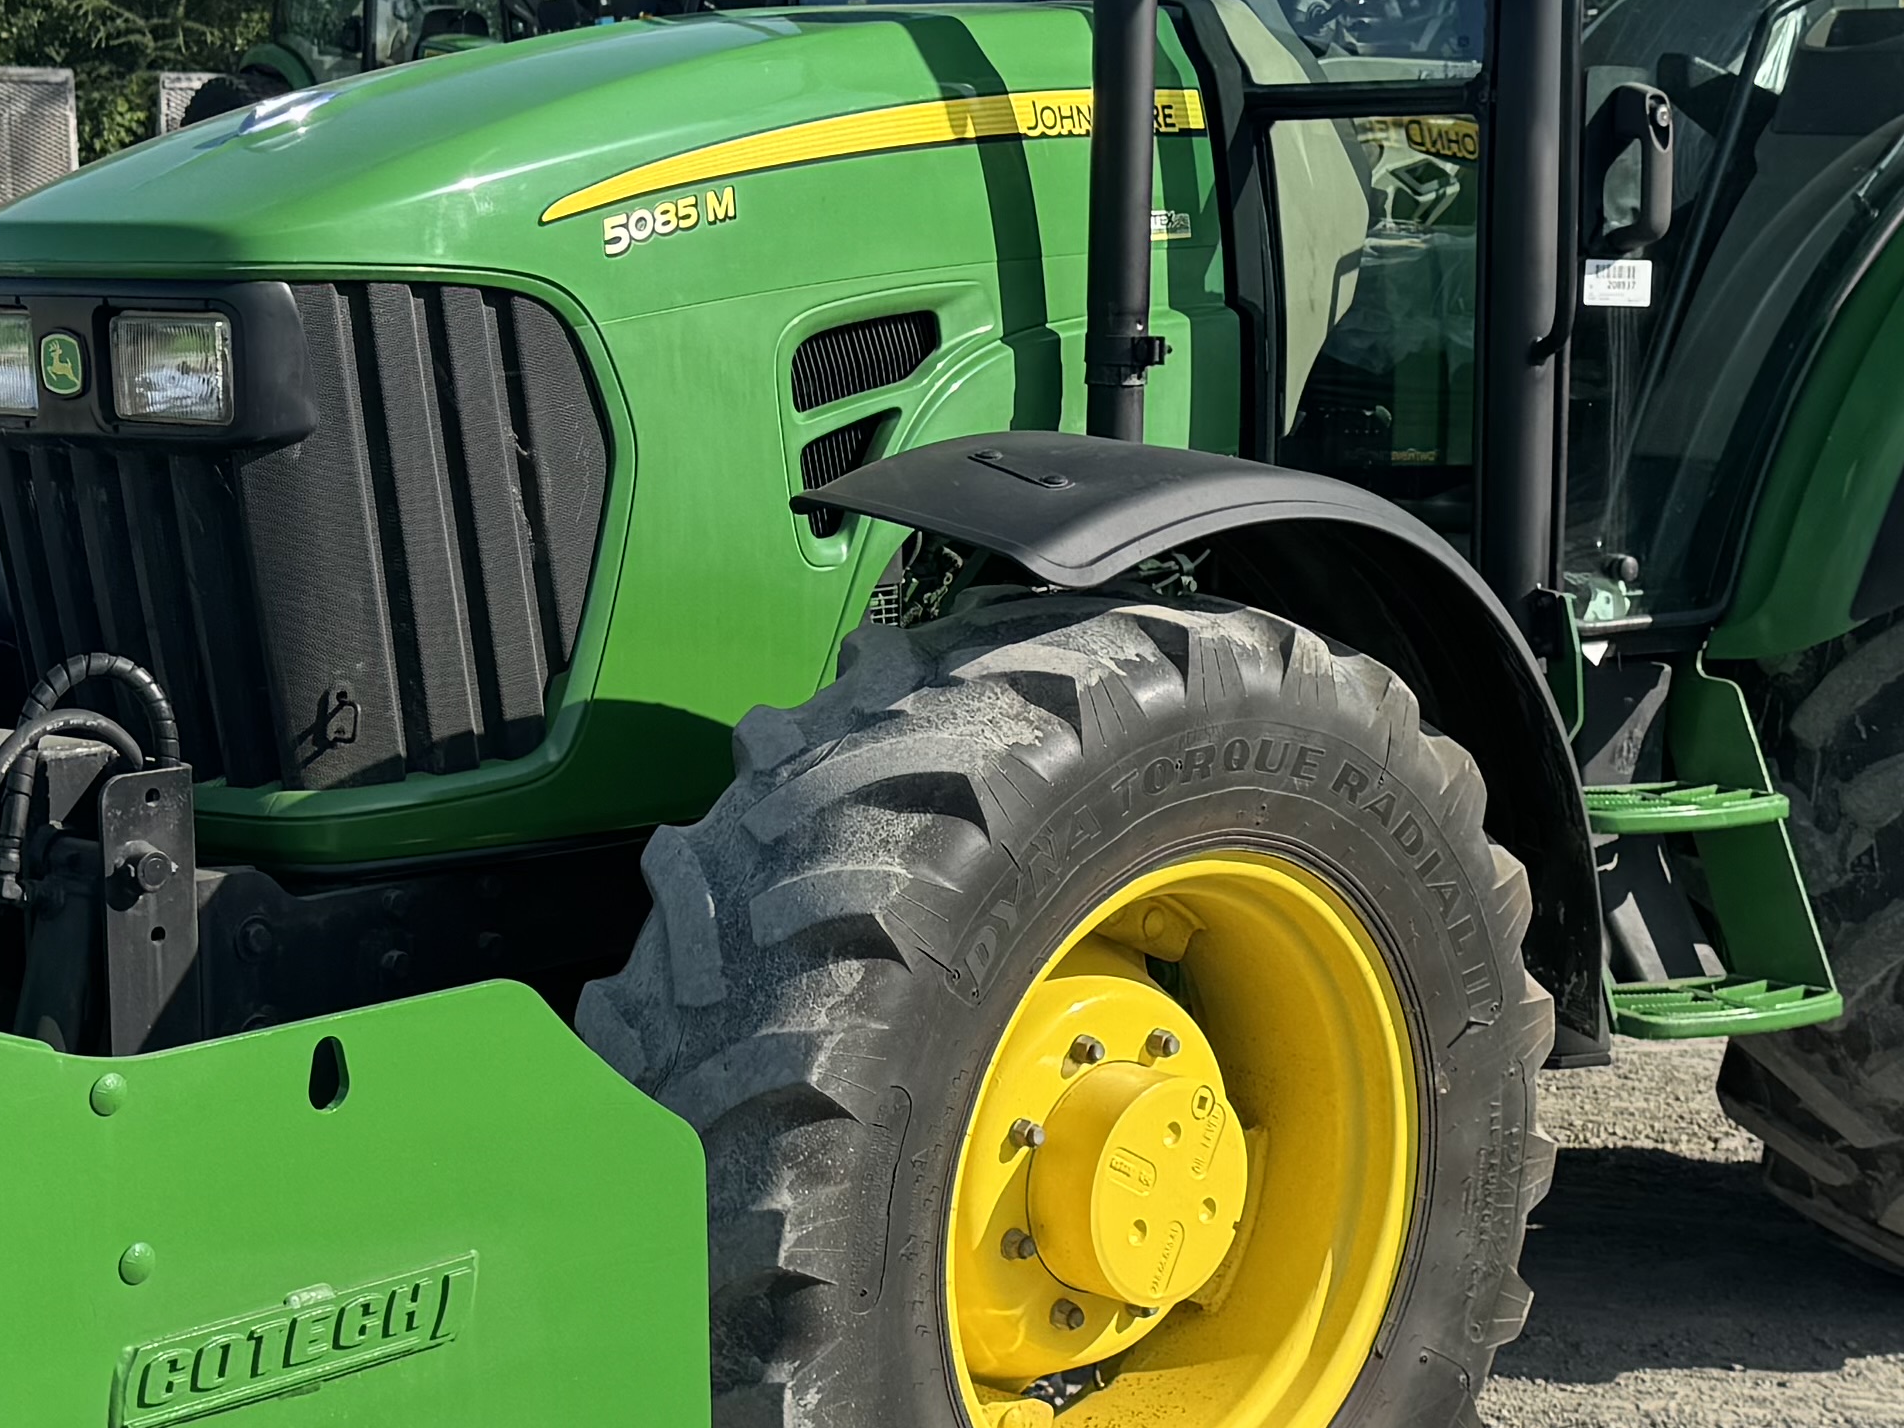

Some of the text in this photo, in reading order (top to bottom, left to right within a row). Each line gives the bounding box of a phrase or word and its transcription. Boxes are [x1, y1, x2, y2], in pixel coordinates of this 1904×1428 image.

[1027, 100, 1092, 130] JOHN
[603, 185, 737, 258] 5085 M
[968, 804, 1103, 986] DYNA
[1112, 736, 1326, 814] TORQUE
[1330, 760, 1481, 957] RADIAL
[136, 1276, 433, 1409] COTECH
